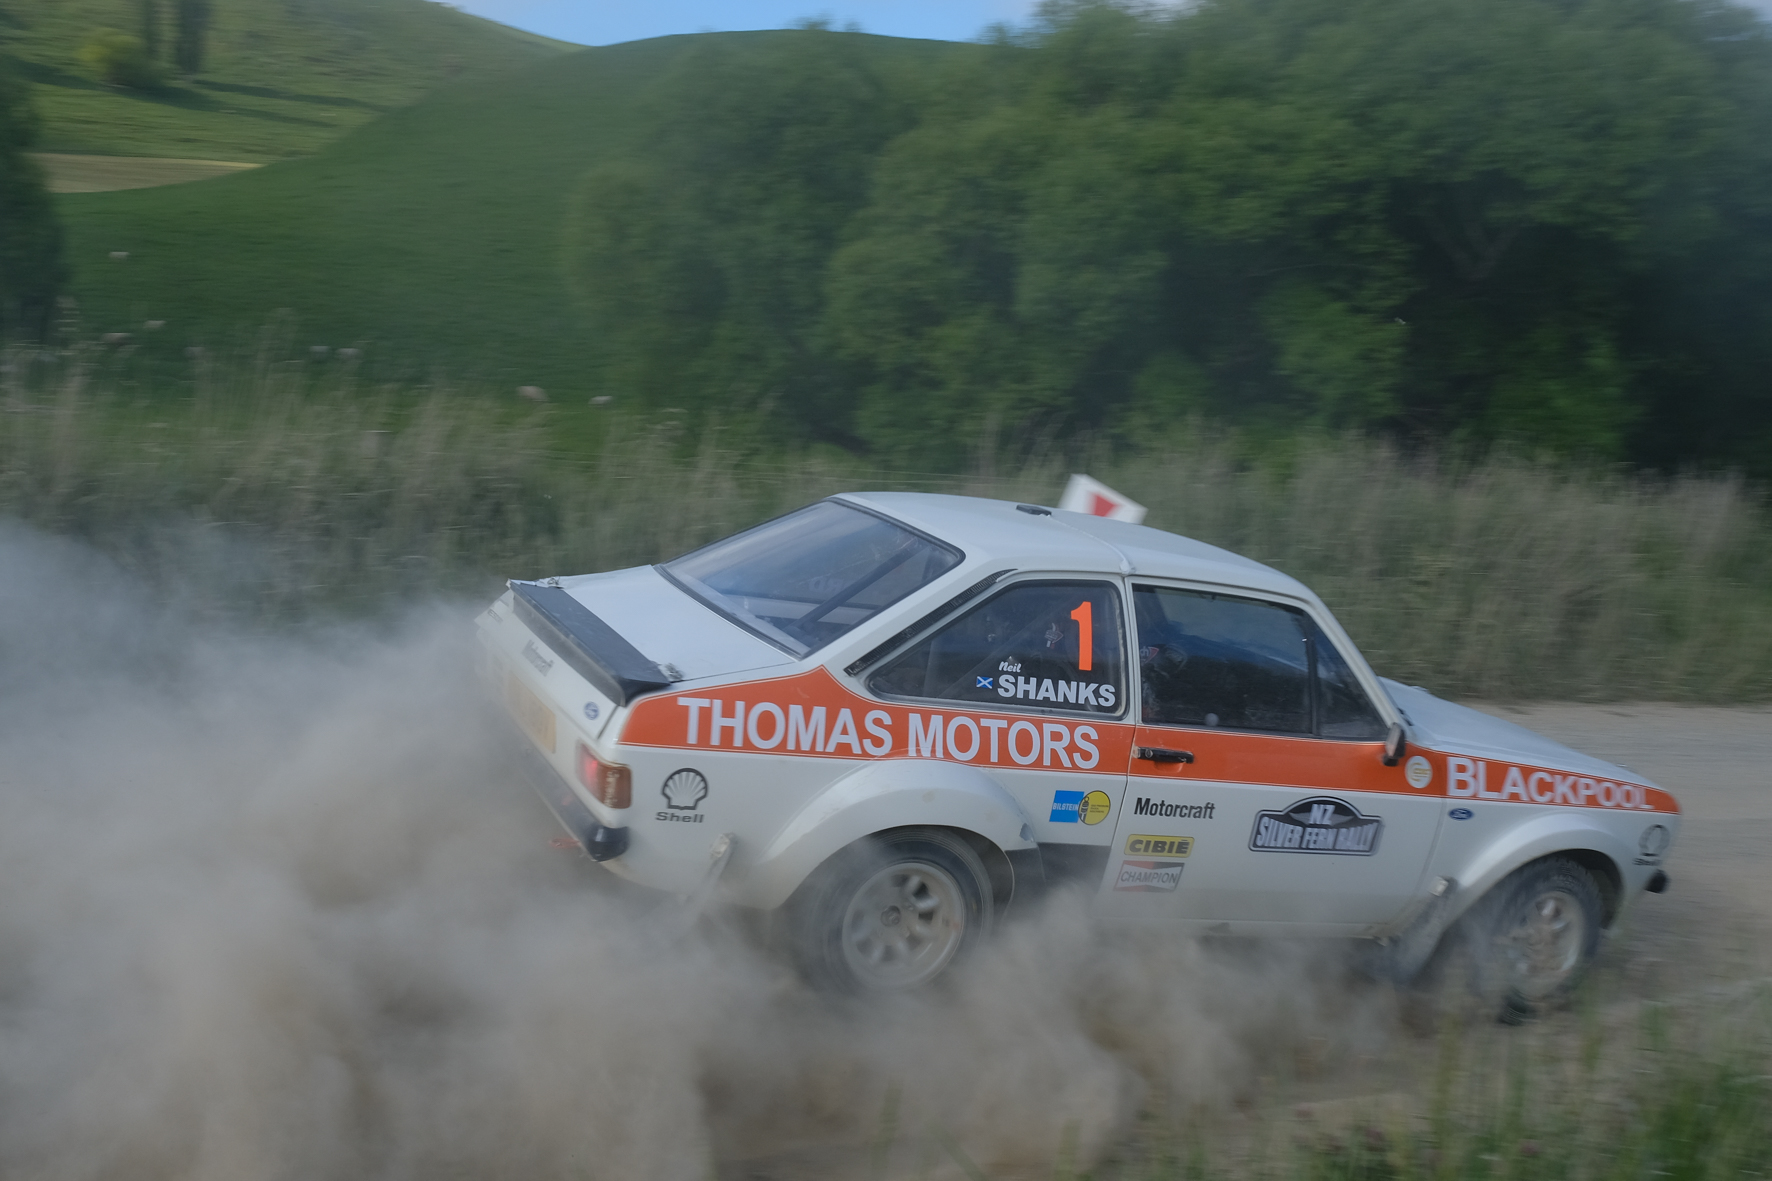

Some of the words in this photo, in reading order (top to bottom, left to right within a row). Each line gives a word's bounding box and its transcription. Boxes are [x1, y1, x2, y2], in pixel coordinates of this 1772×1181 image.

[1070, 601, 1092, 671] 1
[999, 661, 1022, 673] Neil
[997, 674, 1116, 707] SHANKS
[677, 697, 893, 756] THOMAS
[908, 713, 1100, 769] MOTORS
[1446, 757, 1655, 811] BLACKPOOL
[655, 811, 704, 823] Shell
[1052, 802, 1079, 811] BILSTEIN
[1133, 797, 1216, 819] Motorcraft
[1309, 804, 1336, 826] NZ
[1256, 817, 1303, 848] SILVER
[1301, 827, 1338, 849] FERN
[1335, 822, 1379, 851] RALLY
[1120, 871, 1179, 884] CHAMPION
